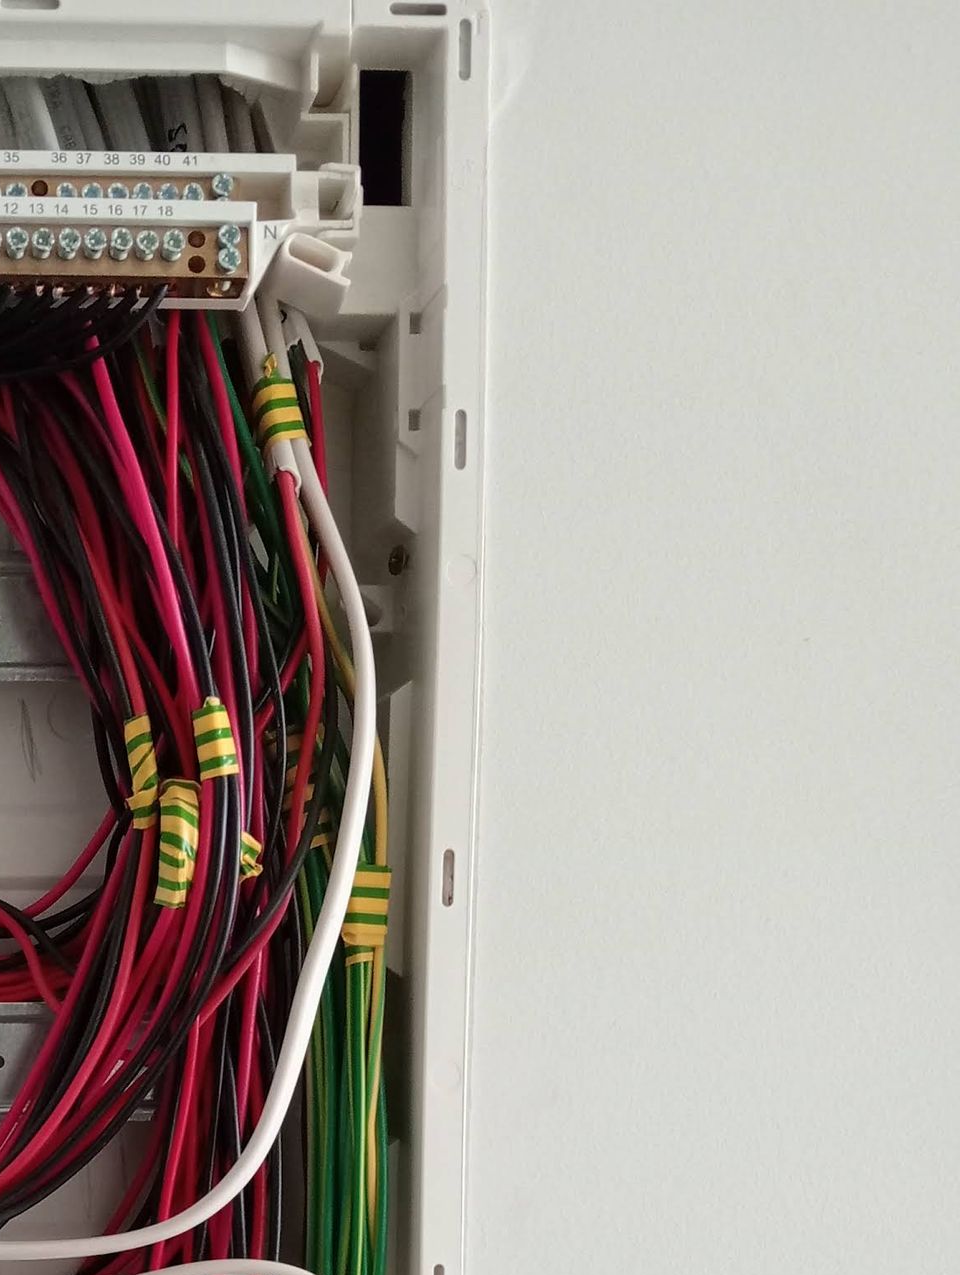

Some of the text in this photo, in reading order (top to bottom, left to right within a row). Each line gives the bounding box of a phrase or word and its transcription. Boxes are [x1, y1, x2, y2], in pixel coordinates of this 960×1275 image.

[4, 152, 19, 163] 35
[52, 152, 67, 163] 36
[77, 153, 91, 164] 37
[104, 153, 119, 165] 38
[130, 154, 145, 165] 39
[154, 155, 170, 165] 40
[183, 156, 197, 166] 41
[4, 203, 18, 214] 12
[30, 203, 44, 214] 13
[55, 204, 68, 215] 14
[83, 204, 98, 215] 15
[109, 205, 122, 216] 16
[134, 205, 147, 215] 17
[158, 206, 173, 216] 18
[265, 225, 277, 240] N
